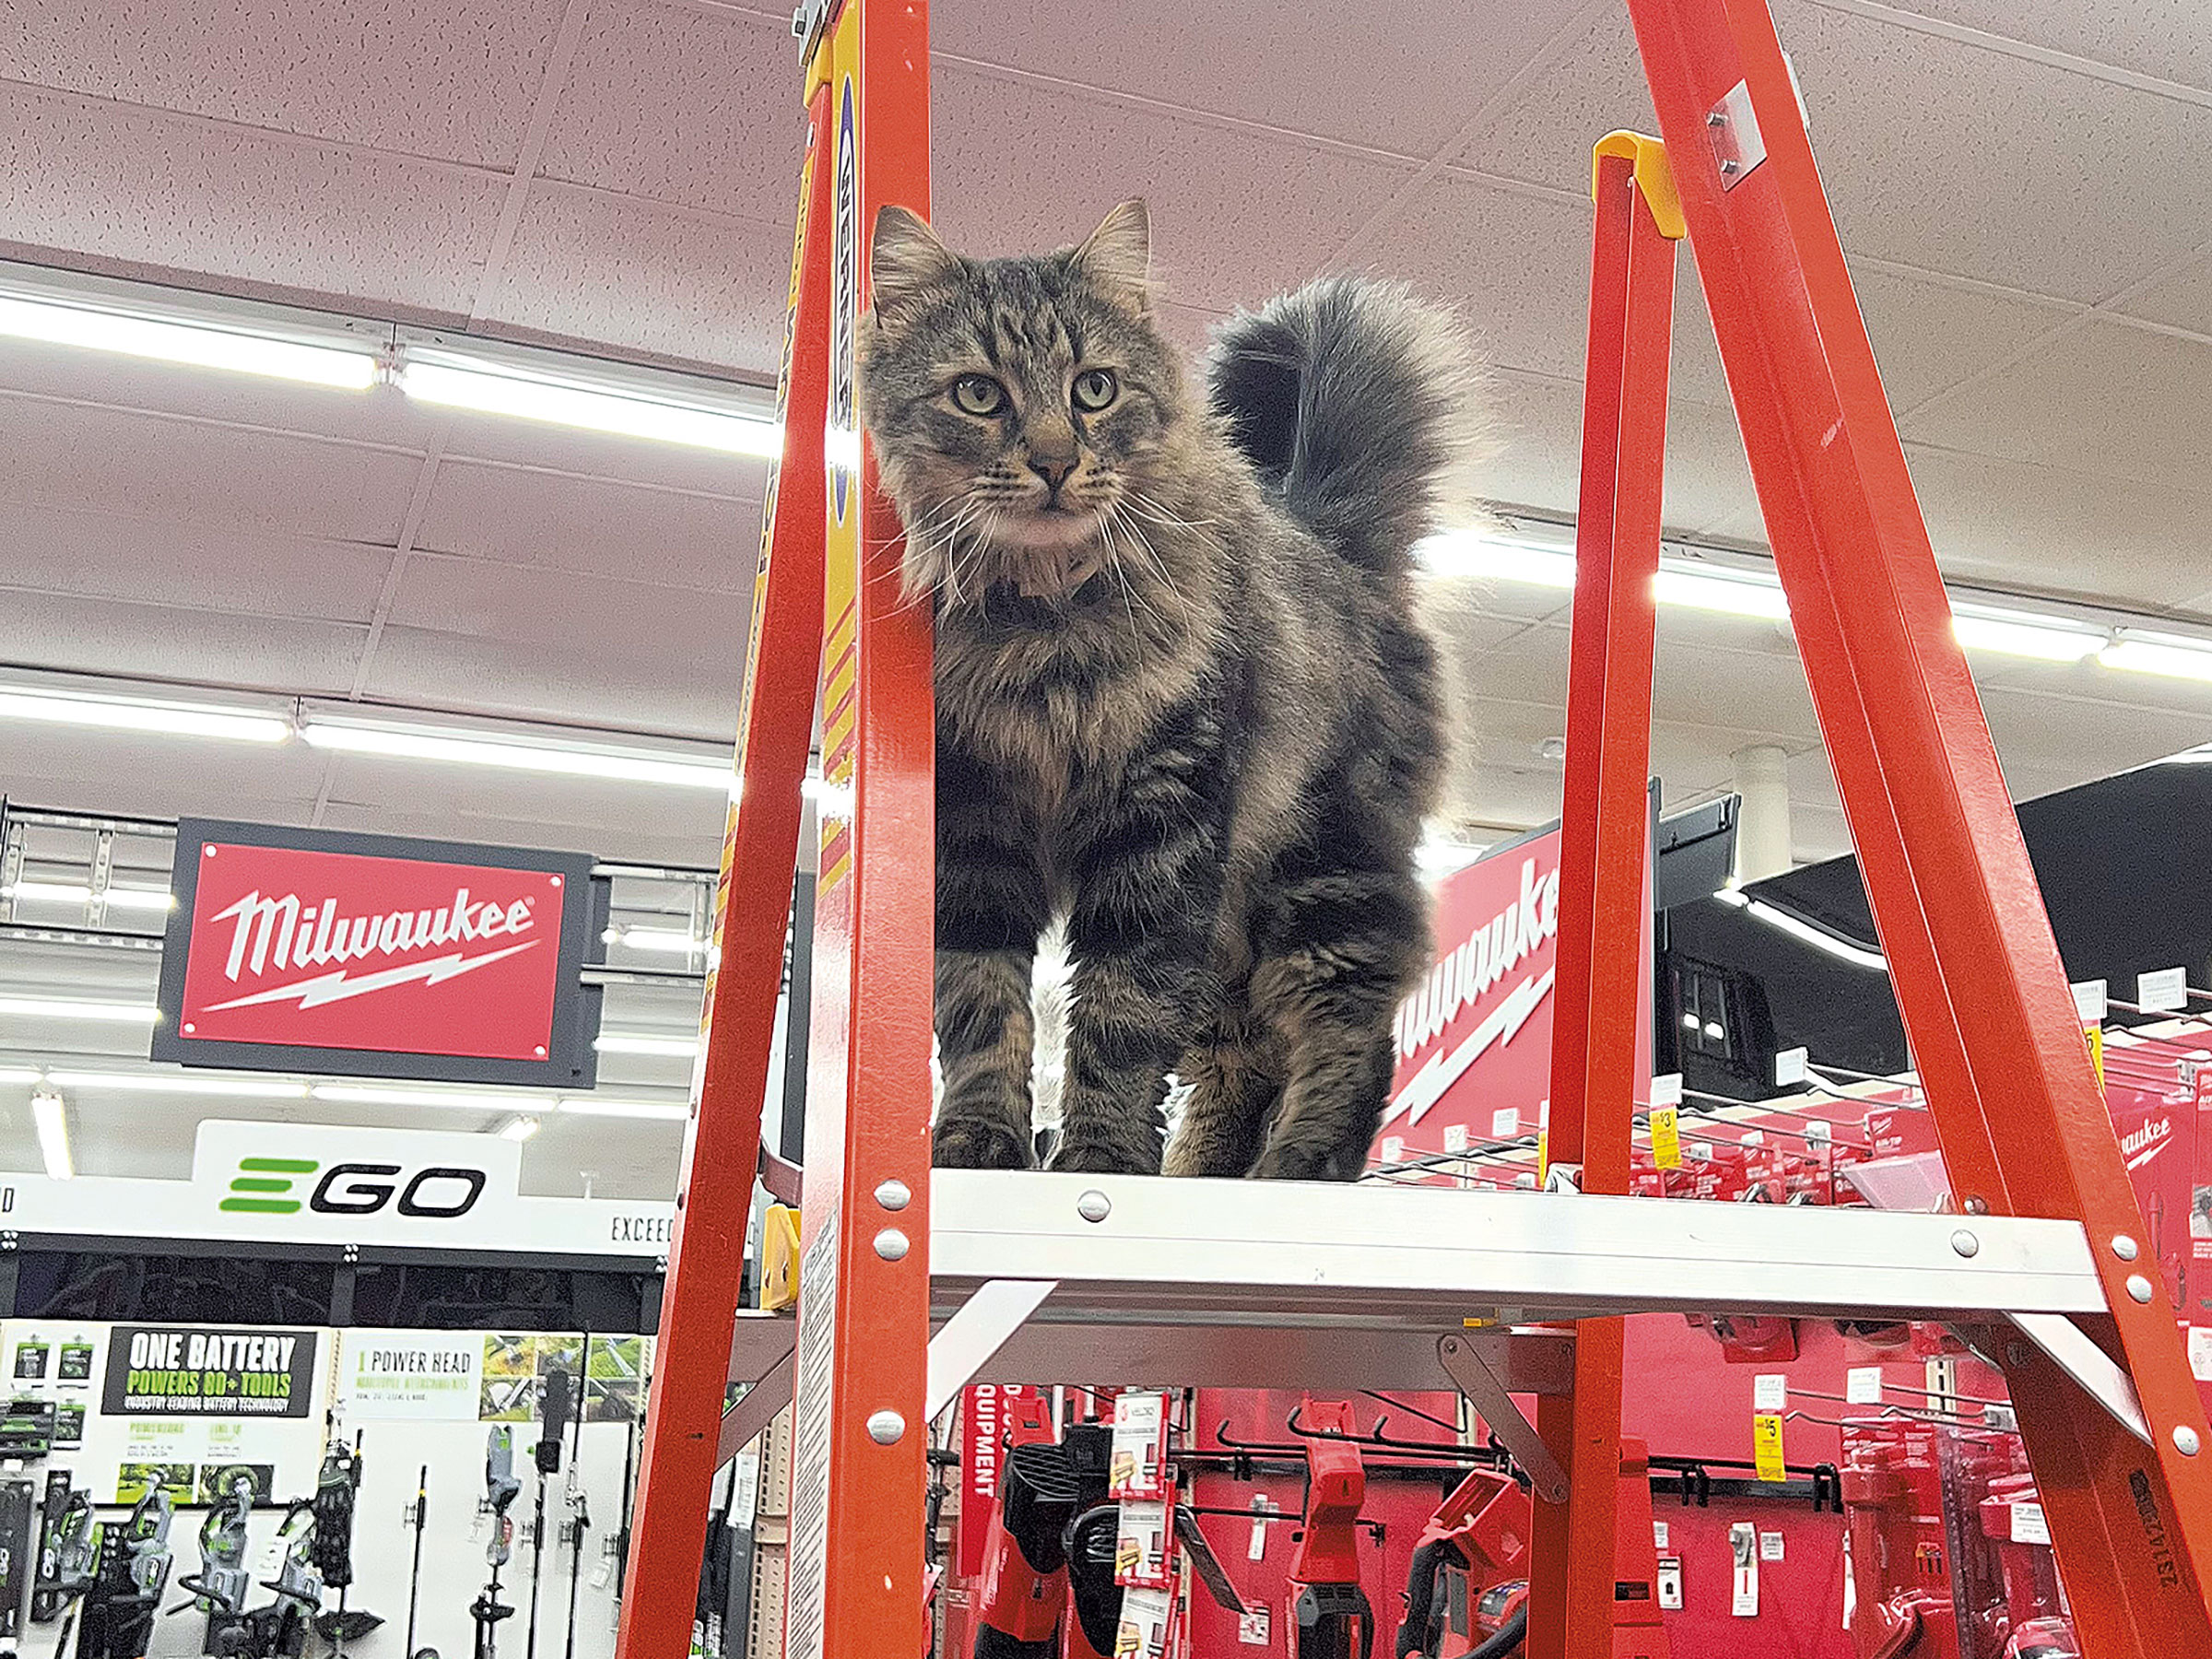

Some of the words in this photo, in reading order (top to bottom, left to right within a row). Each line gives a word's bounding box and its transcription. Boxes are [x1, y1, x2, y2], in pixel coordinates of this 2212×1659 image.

[838, 153, 852, 426] WERNER
[209, 888, 535, 982] Milwaukee
[219, 1157, 487, 1218] EGO
[129, 1332, 183, 1370] ONE
[187, 1334, 296, 1371] BATTERY
[371, 1350, 427, 1372] POWER
[431, 1351, 470, 1373] HEAD
[126, 1370, 199, 1395] POWERS
[241, 1371, 292, 1397] TOOLS
[974, 1383, 996, 1498] QUIPMENT
